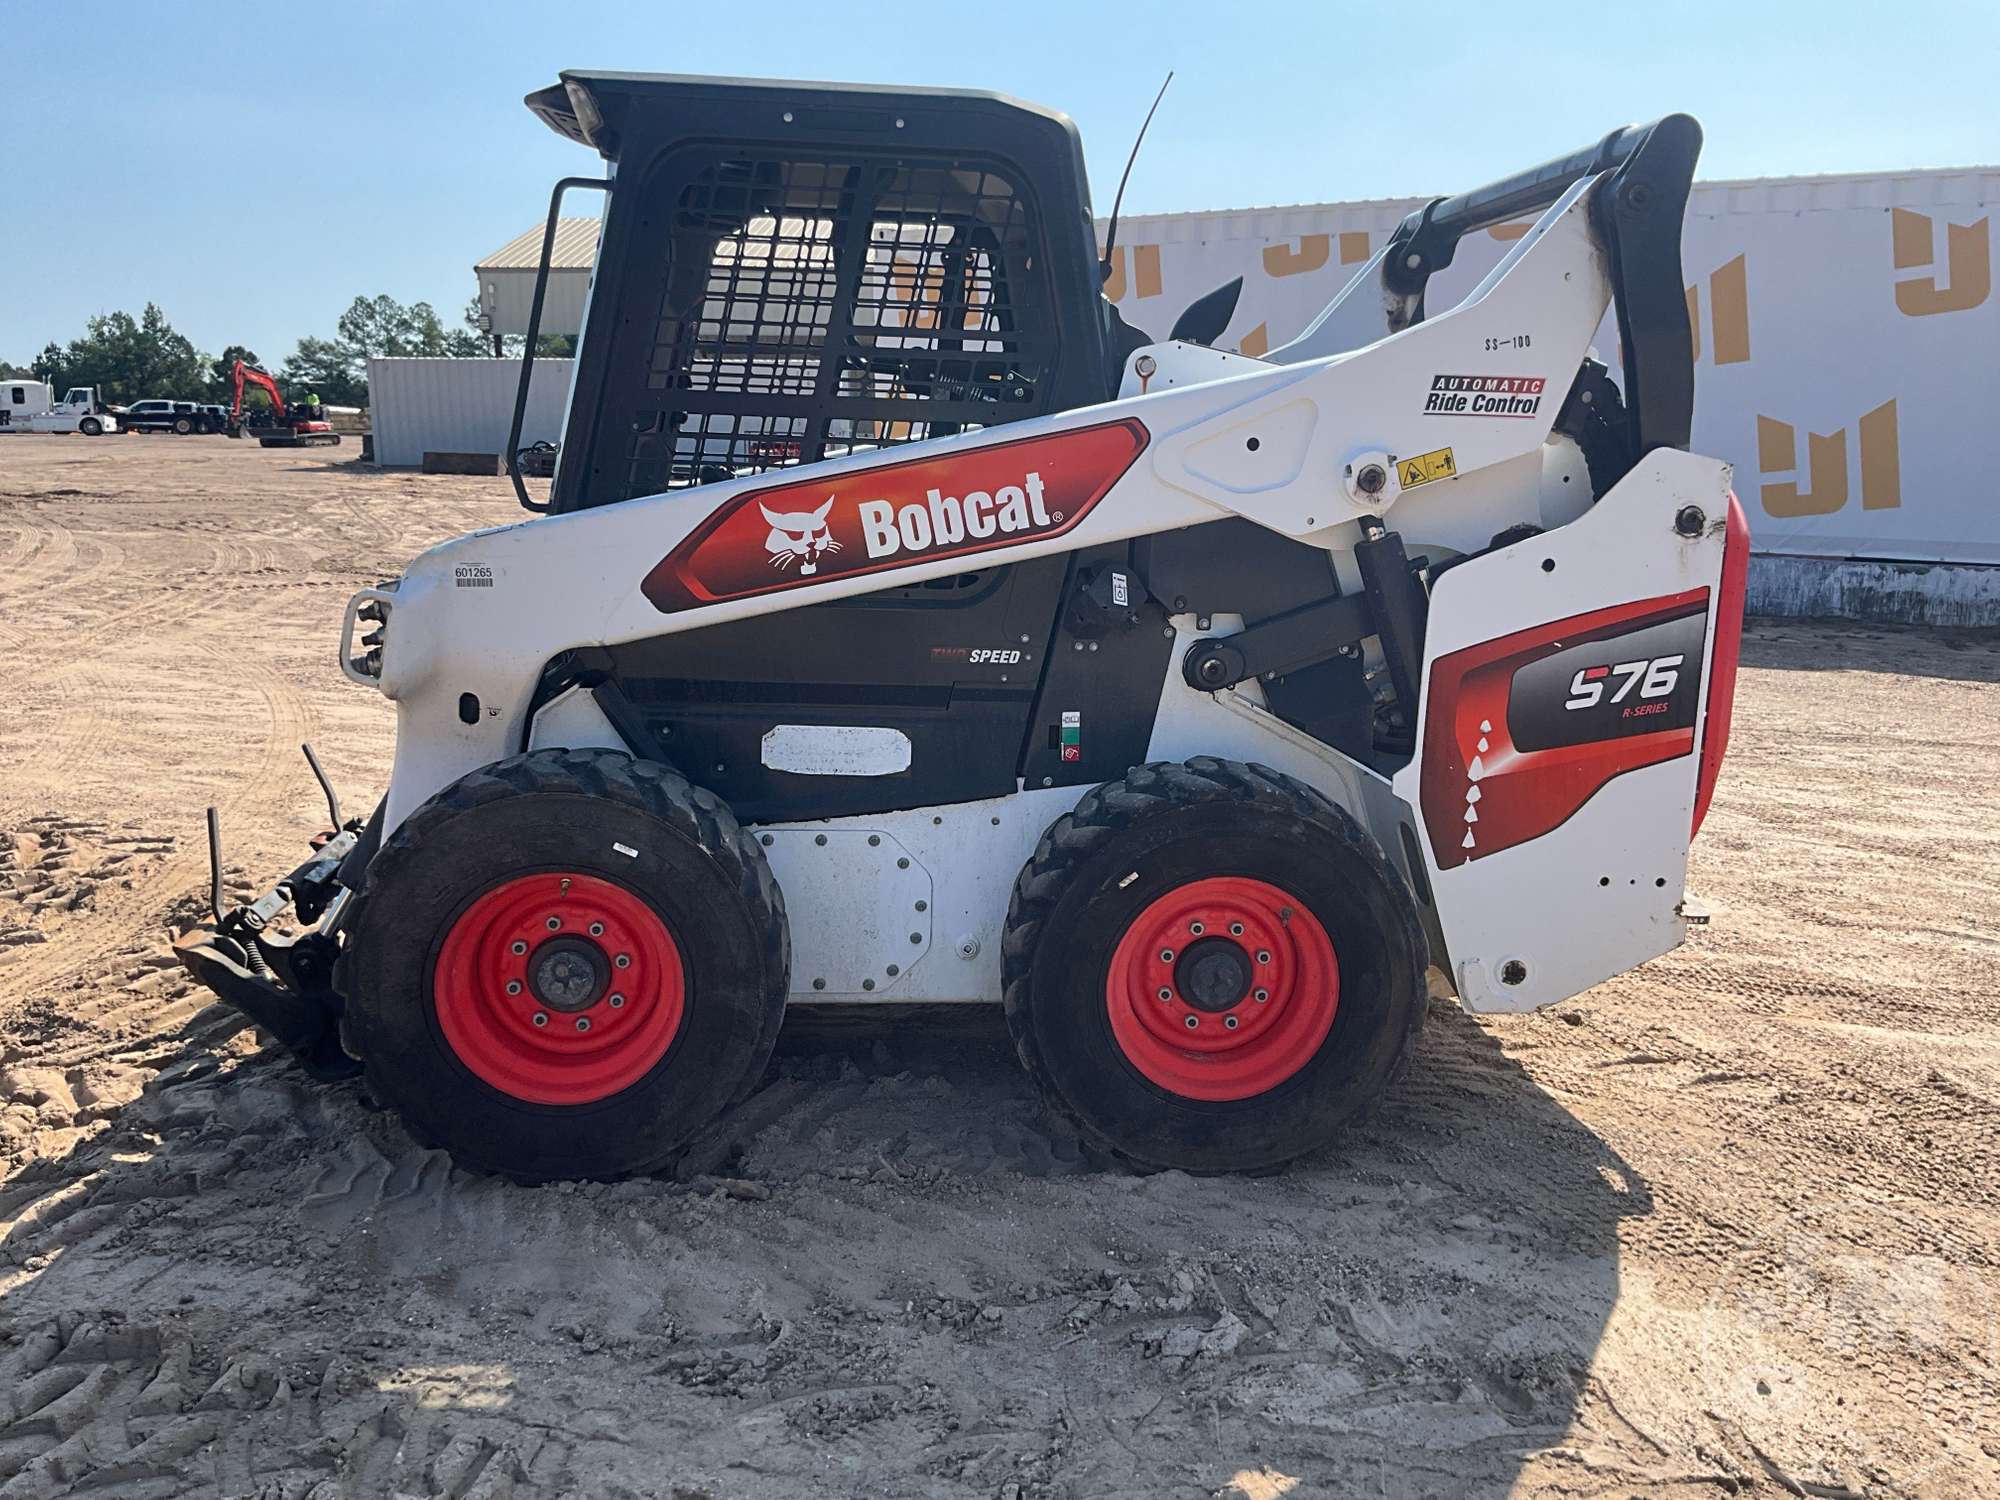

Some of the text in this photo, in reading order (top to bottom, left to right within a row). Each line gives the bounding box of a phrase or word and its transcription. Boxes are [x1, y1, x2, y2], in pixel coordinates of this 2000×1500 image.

[1435, 377, 1542, 392] AUTOMATIC
[1425, 393, 1541, 414] Ride Control
[858, 472, 1050, 559] Bobcat
[455, 567, 493, 578] 601265
[969, 649, 1021, 664] SPEED
[1565, 654, 1684, 710] S76
[1622, 702, 1669, 718] R-SERIES
